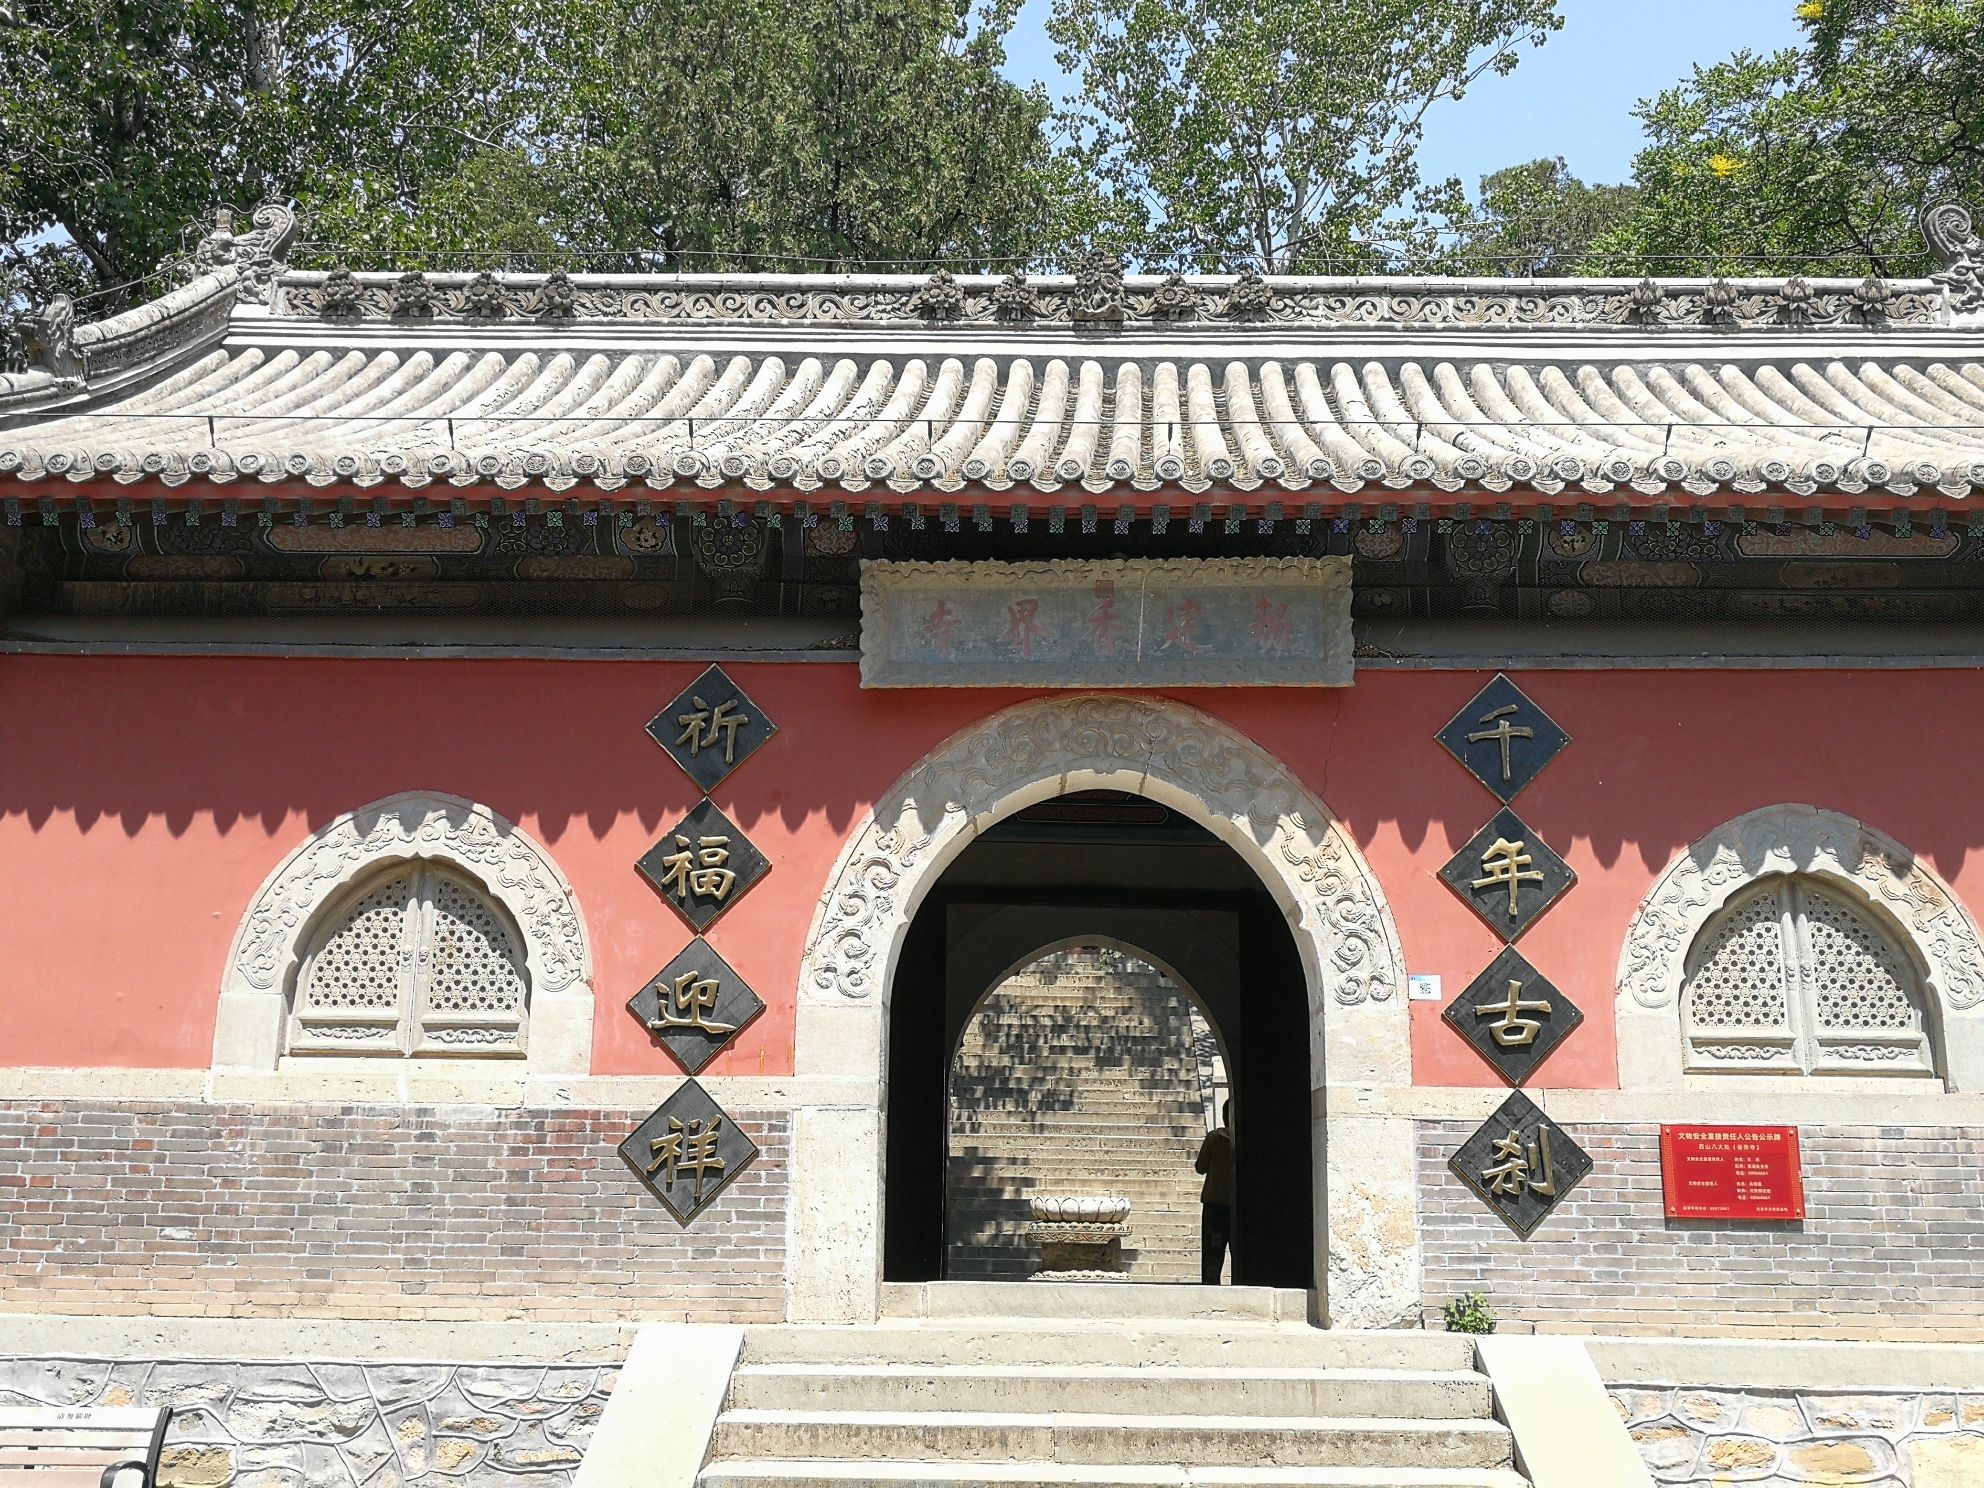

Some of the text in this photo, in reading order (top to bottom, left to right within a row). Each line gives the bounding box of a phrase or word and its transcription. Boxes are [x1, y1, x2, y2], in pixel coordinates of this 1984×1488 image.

[647, 695, 749, 1198] 祈福迎祥
[1467, 704, 1556, 1196] 千年古刹
